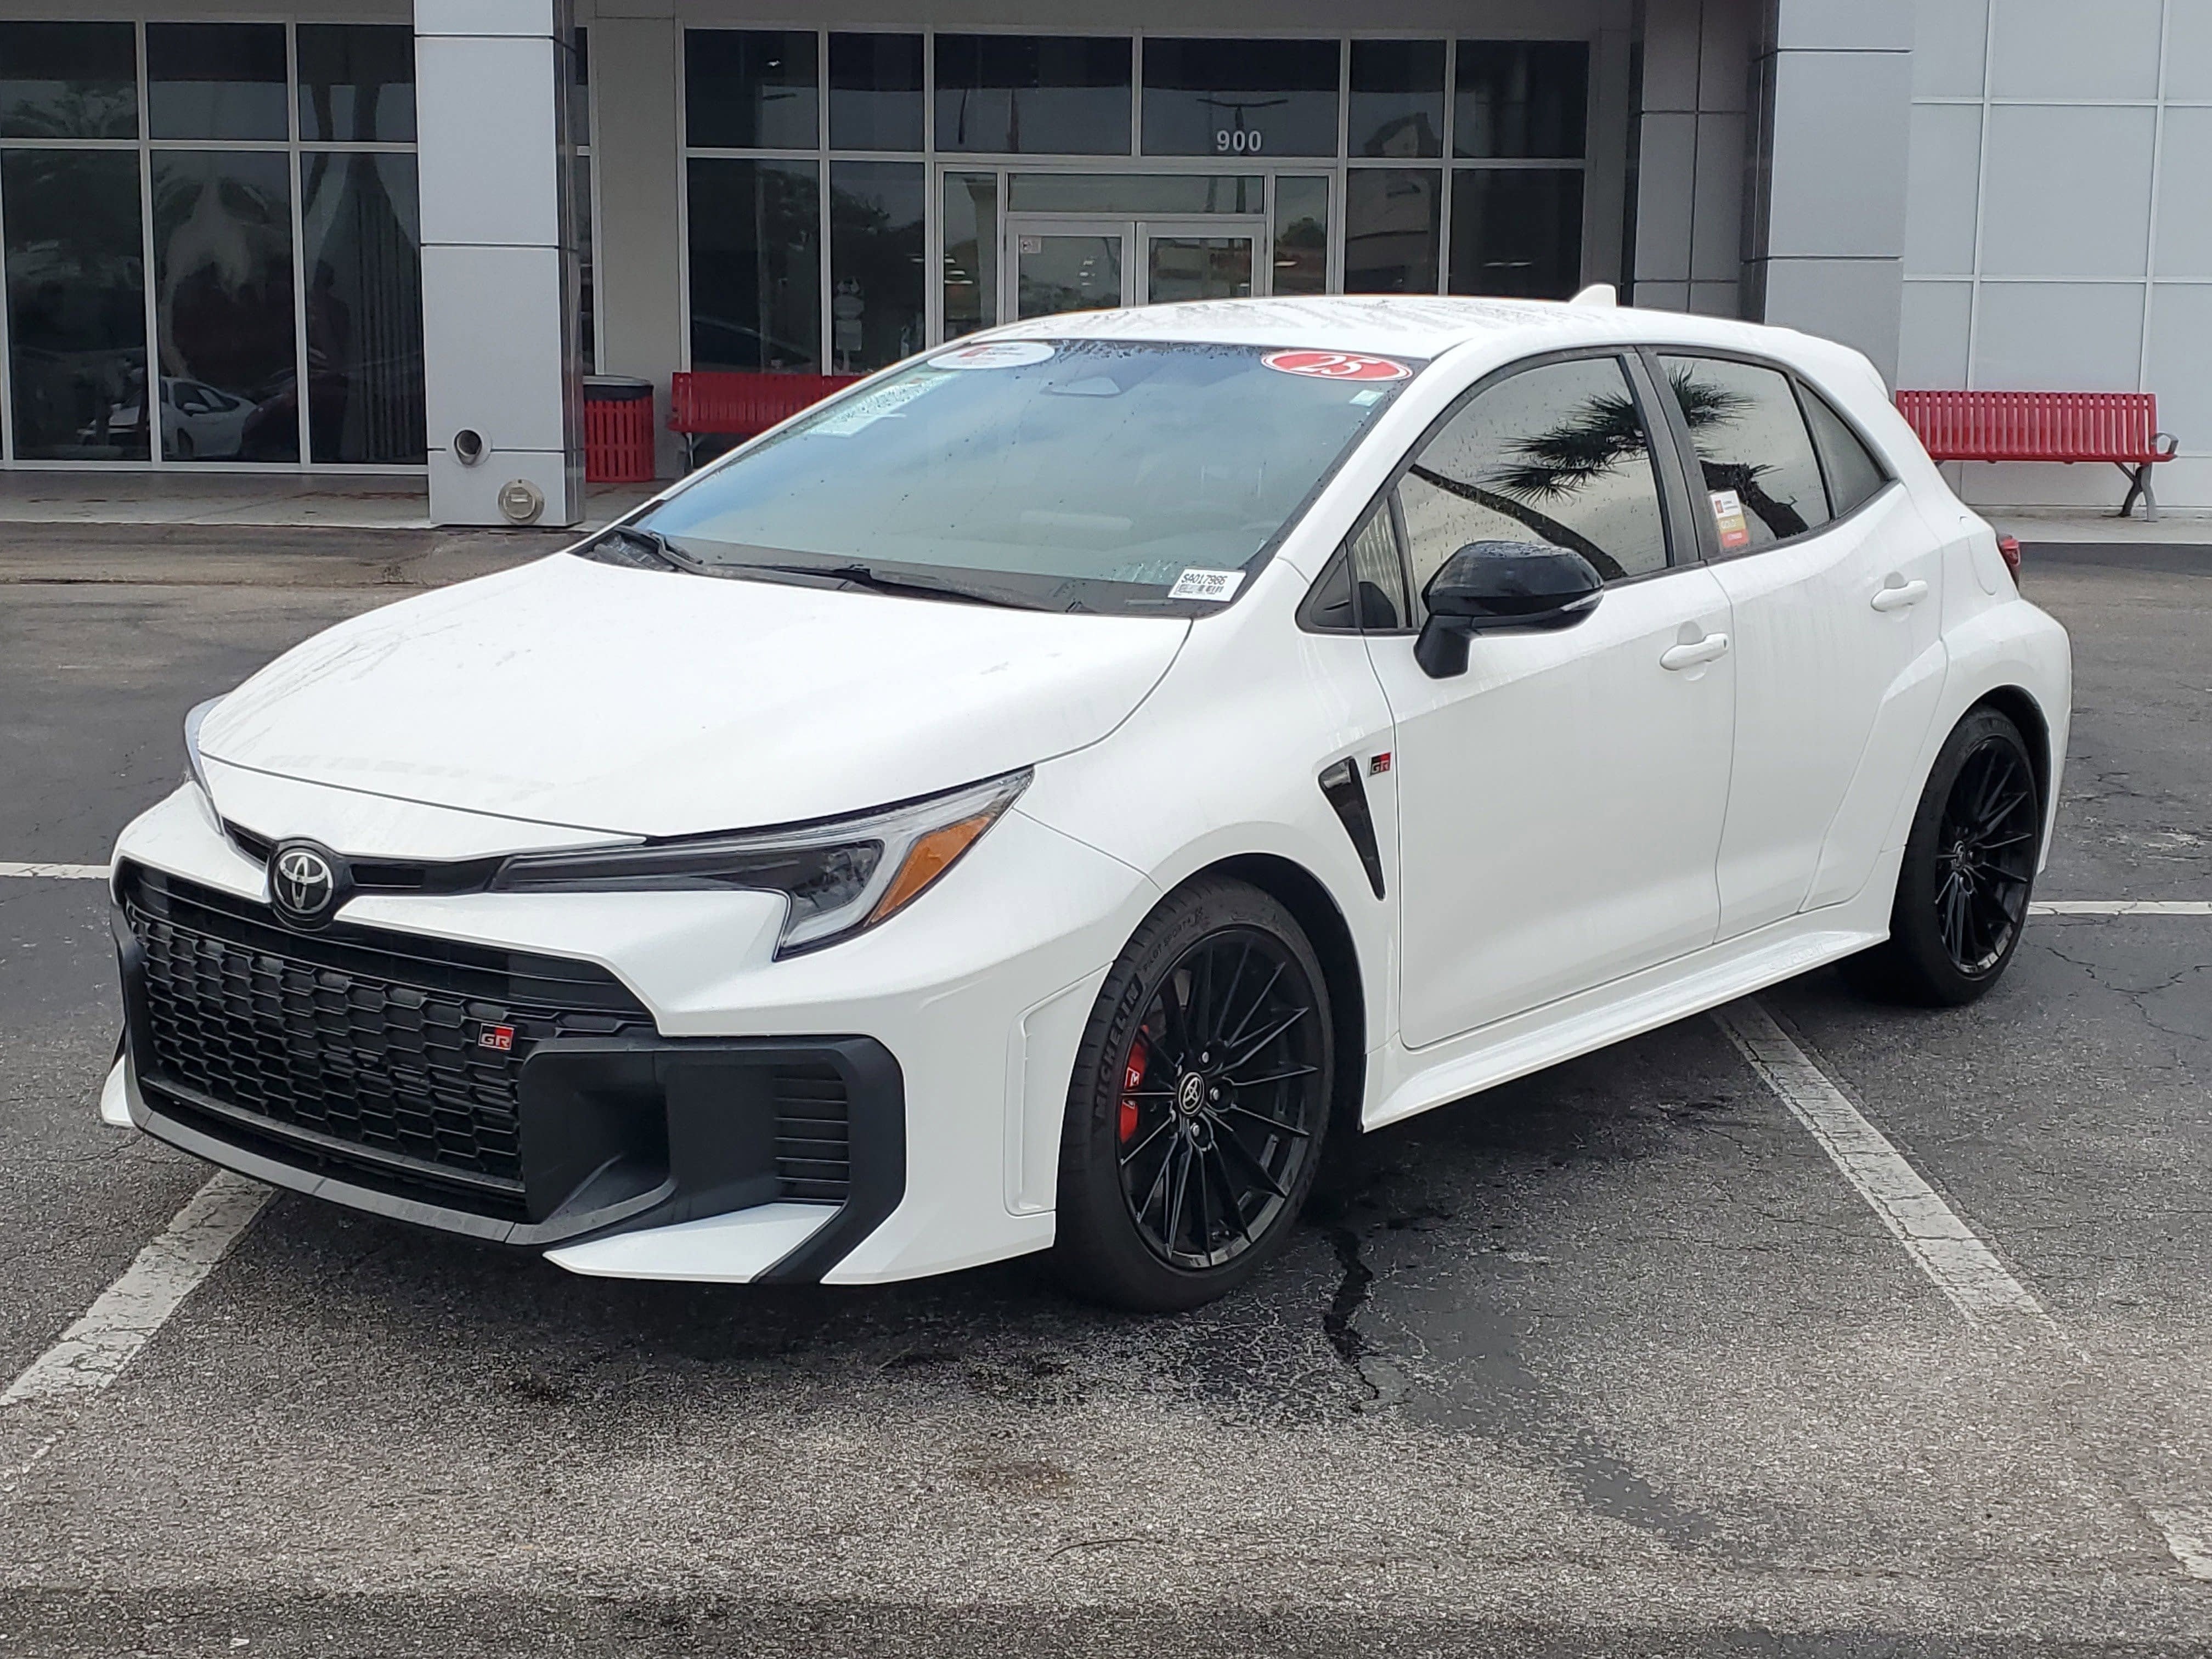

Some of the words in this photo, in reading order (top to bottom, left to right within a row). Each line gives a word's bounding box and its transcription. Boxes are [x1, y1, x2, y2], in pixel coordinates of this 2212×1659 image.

[1216, 129, 1262, 151] 900
[1290, 355, 1381, 375] 25
[1371, 759, 1390, 775] GR
[481, 1032, 511, 1048] GR
[1093, 980, 1141, 1120] MICHELIN
